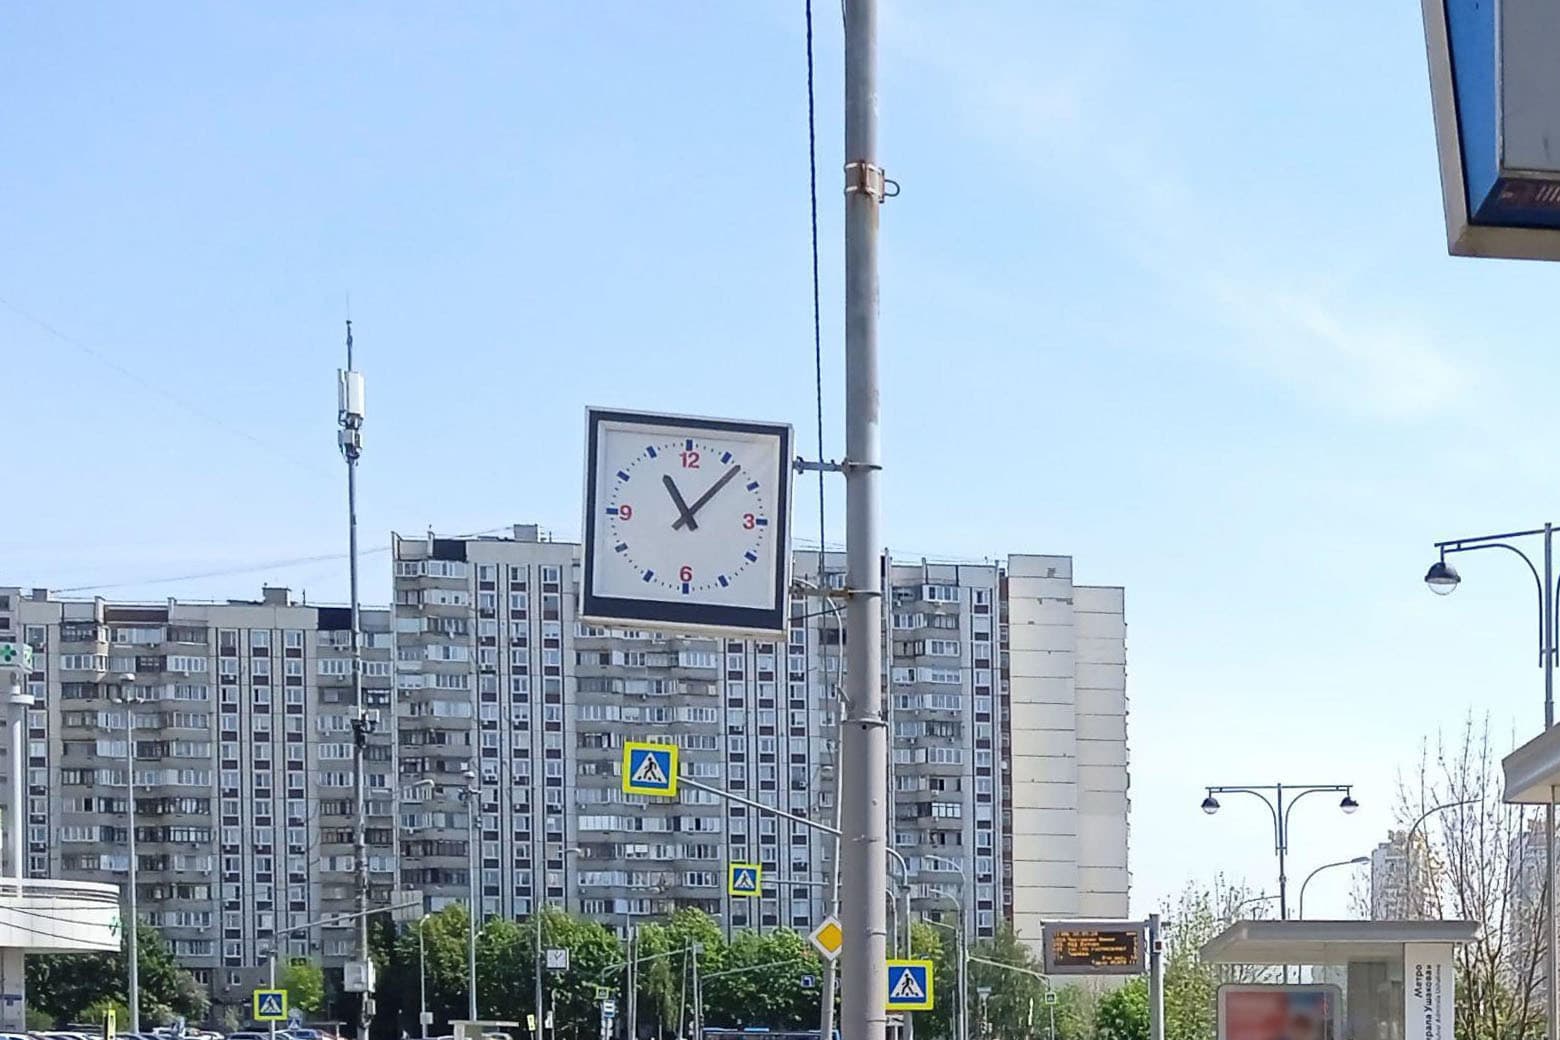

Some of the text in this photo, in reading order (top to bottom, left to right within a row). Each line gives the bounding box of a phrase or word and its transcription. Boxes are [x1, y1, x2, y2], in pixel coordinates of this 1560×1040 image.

[679, 452, 700, 469] 12
[619, 504, 633, 521] 9
[742, 513, 755, 530] 3
[679, 566, 692, 582] 6
[1413, 964, 1423, 998] Метро
